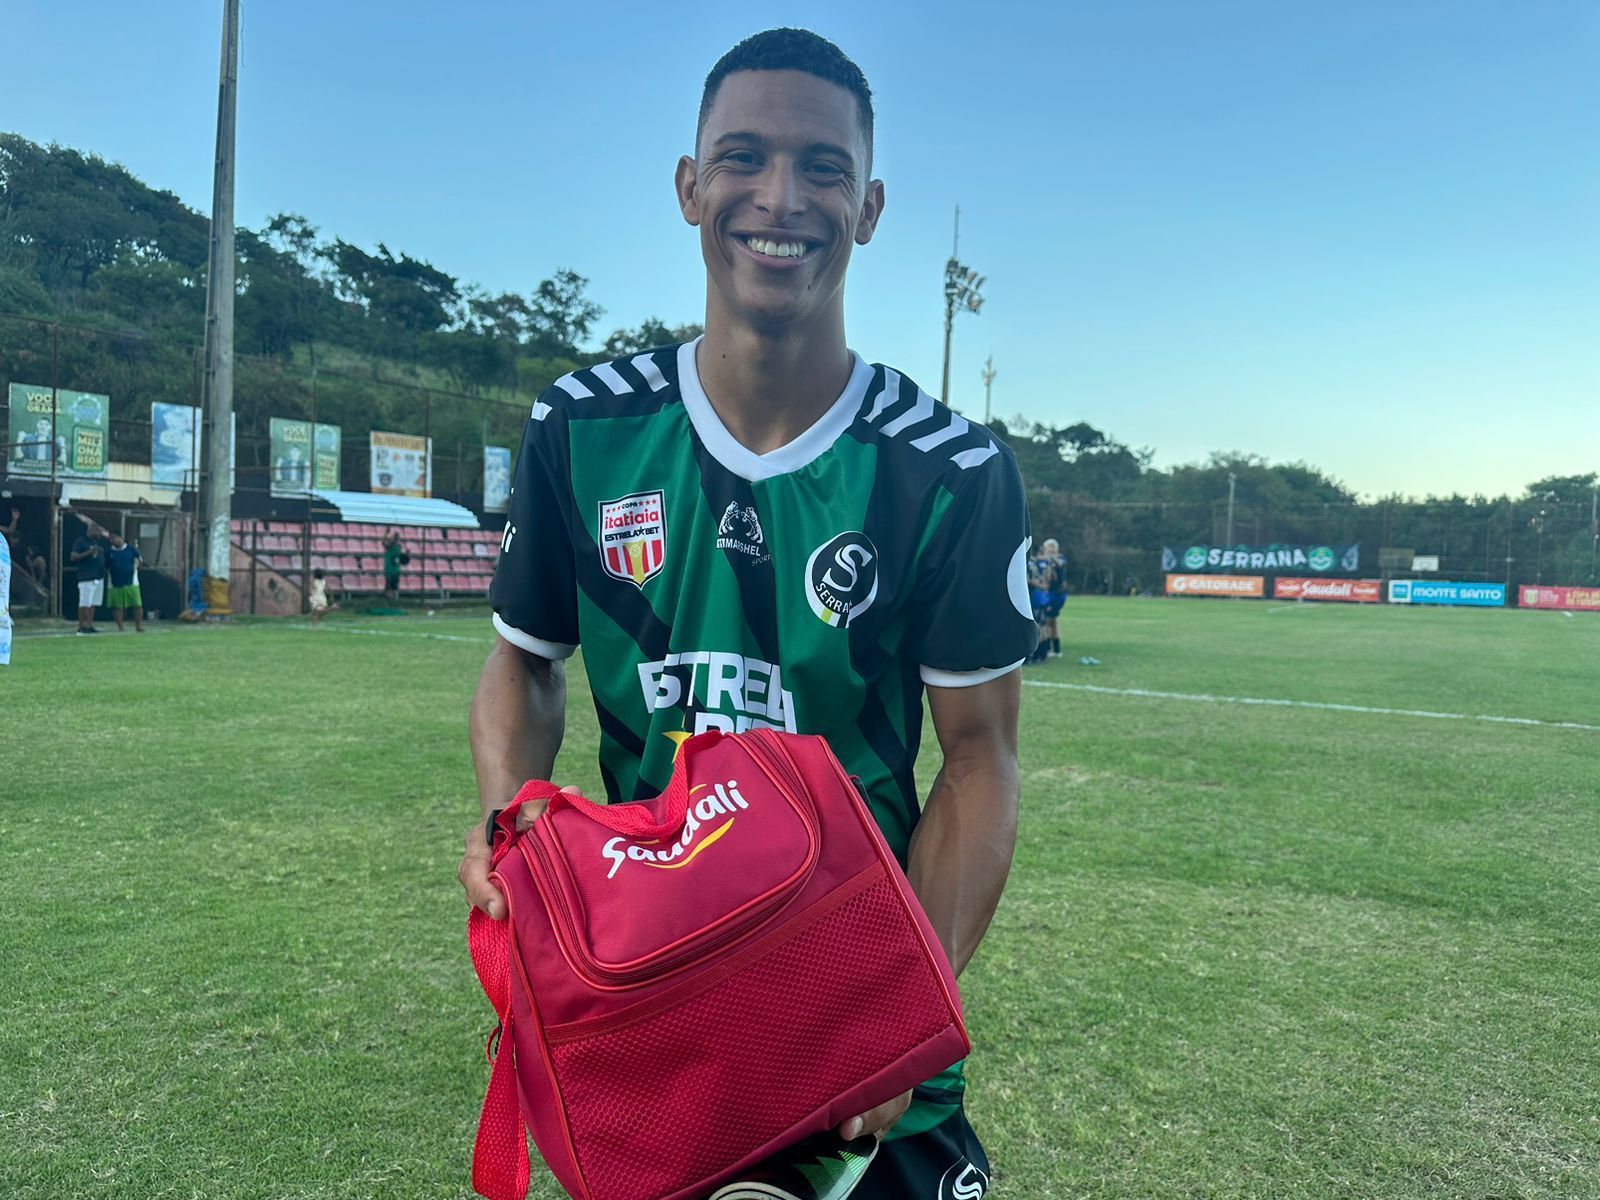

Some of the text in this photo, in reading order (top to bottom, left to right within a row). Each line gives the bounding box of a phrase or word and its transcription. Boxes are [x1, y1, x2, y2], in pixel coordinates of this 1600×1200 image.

[27, 393, 59, 402] VOC
[621, 501, 638, 509] COPA
[605, 508, 659, 530] itatiaia
[1207, 548, 1307, 569] SERRANA
[815, 582, 853, 614] SERRA
[1459, 588, 1502, 600] SANTO
[602, 779, 749, 879] Saudali
